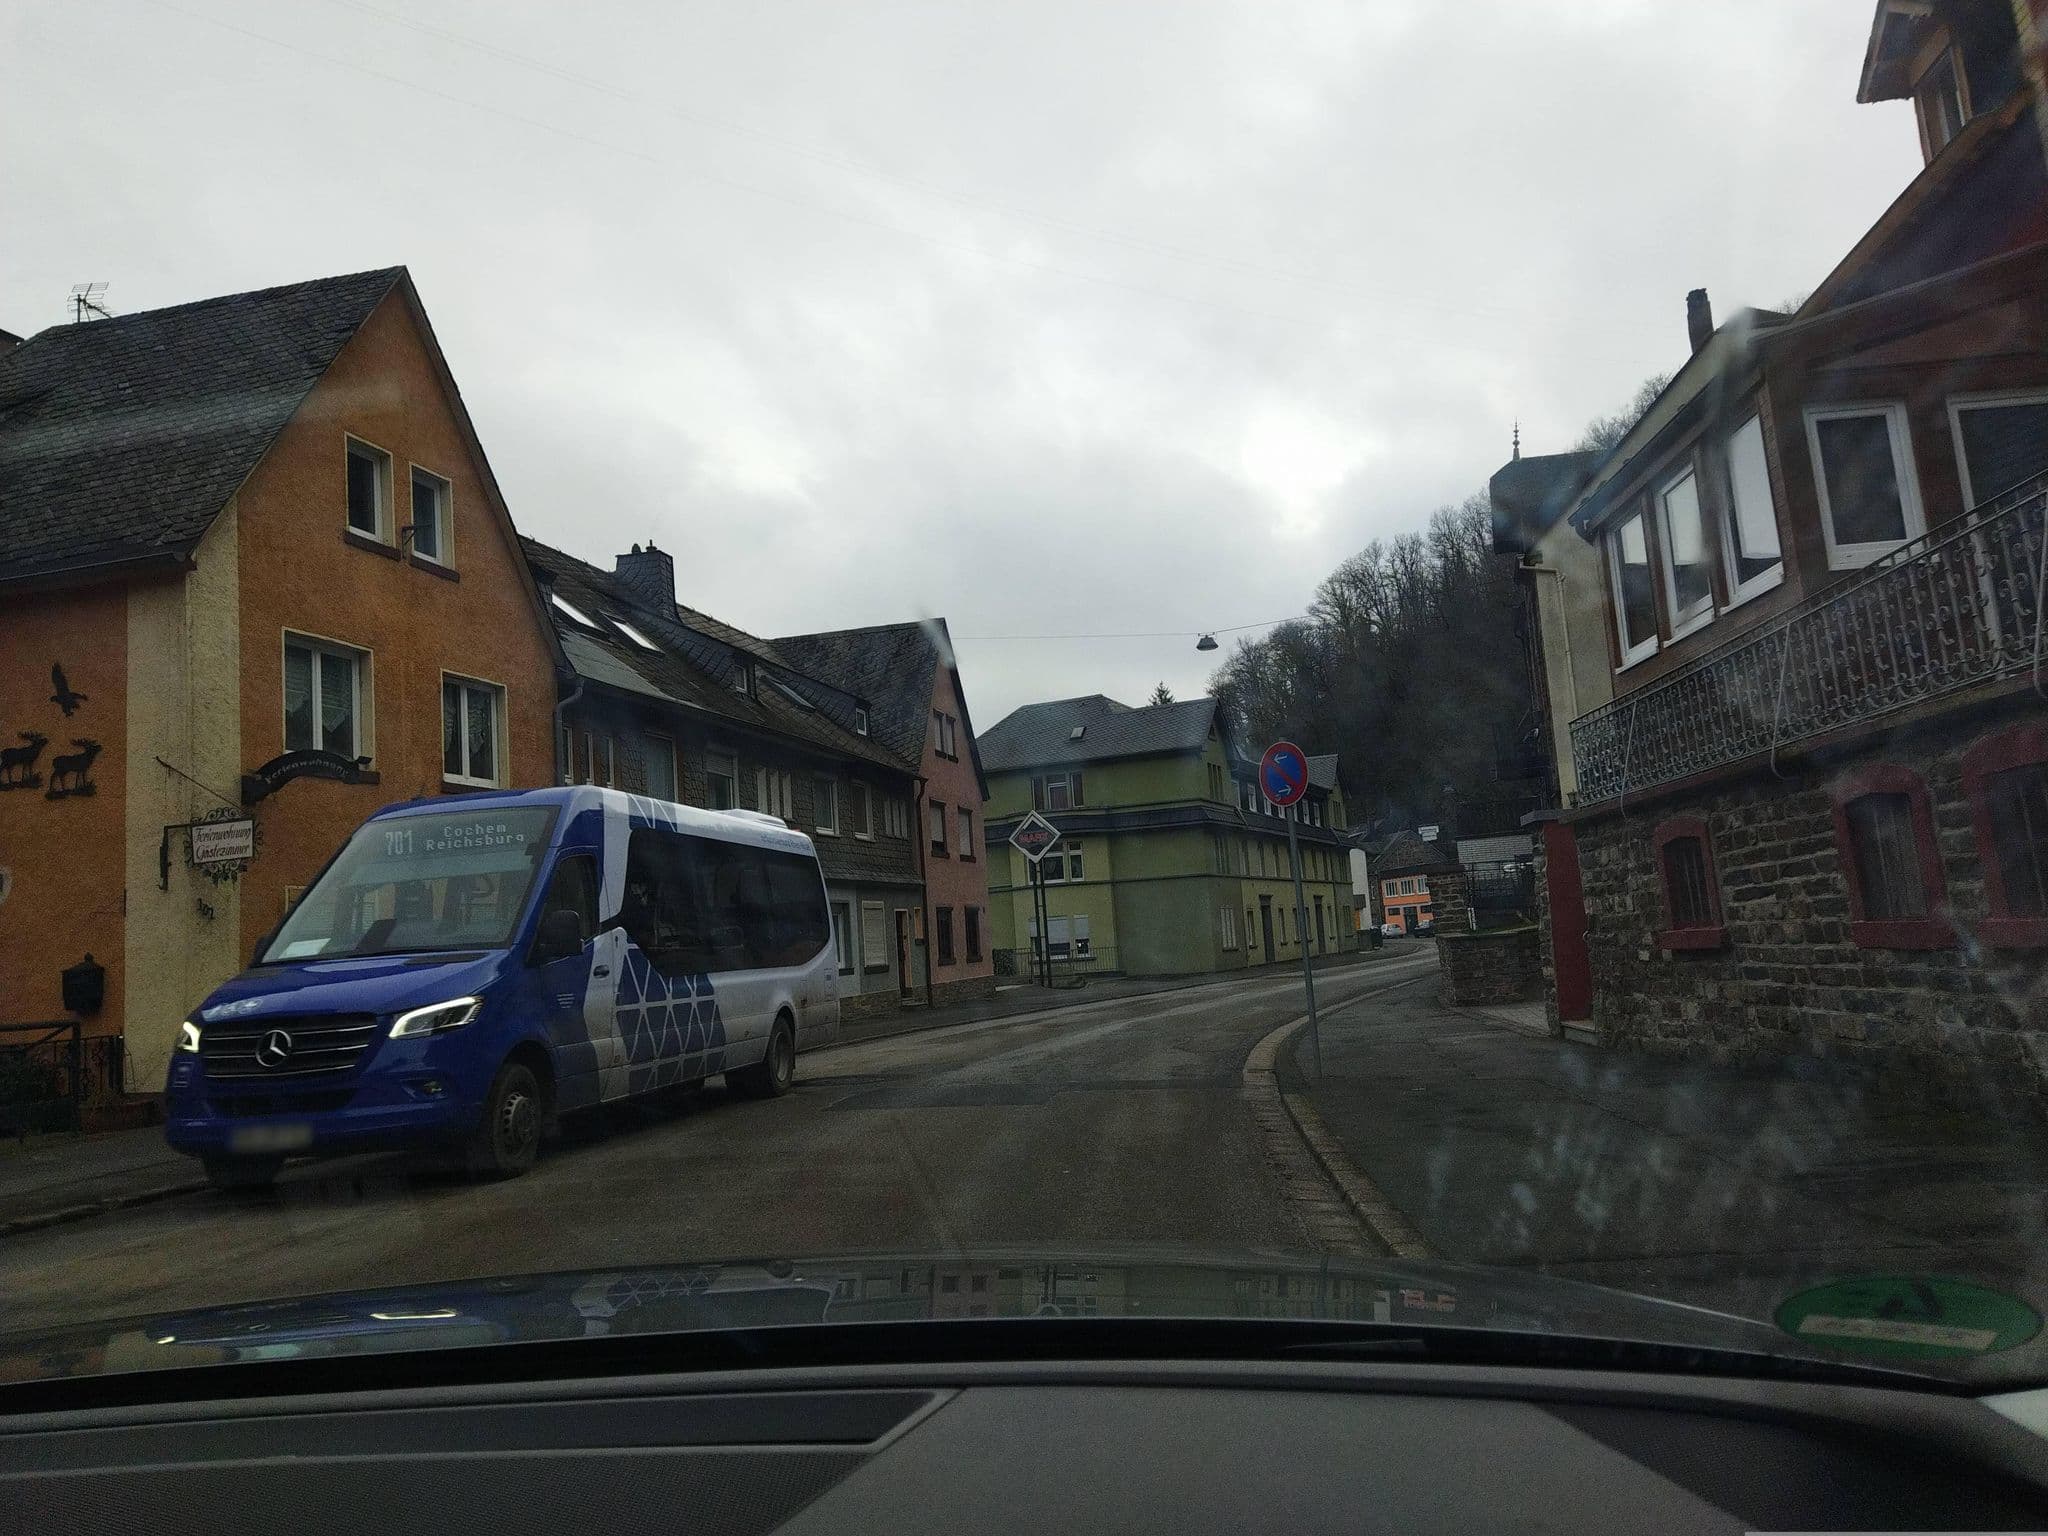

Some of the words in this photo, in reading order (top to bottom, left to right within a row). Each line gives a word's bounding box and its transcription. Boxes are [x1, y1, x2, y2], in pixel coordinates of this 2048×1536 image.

[194, 824, 251, 843] Ferienwohnung
[443, 823, 507, 838] Cochem
[385, 830, 413, 856] 701
[425, 833, 524, 852] Reichsburg
